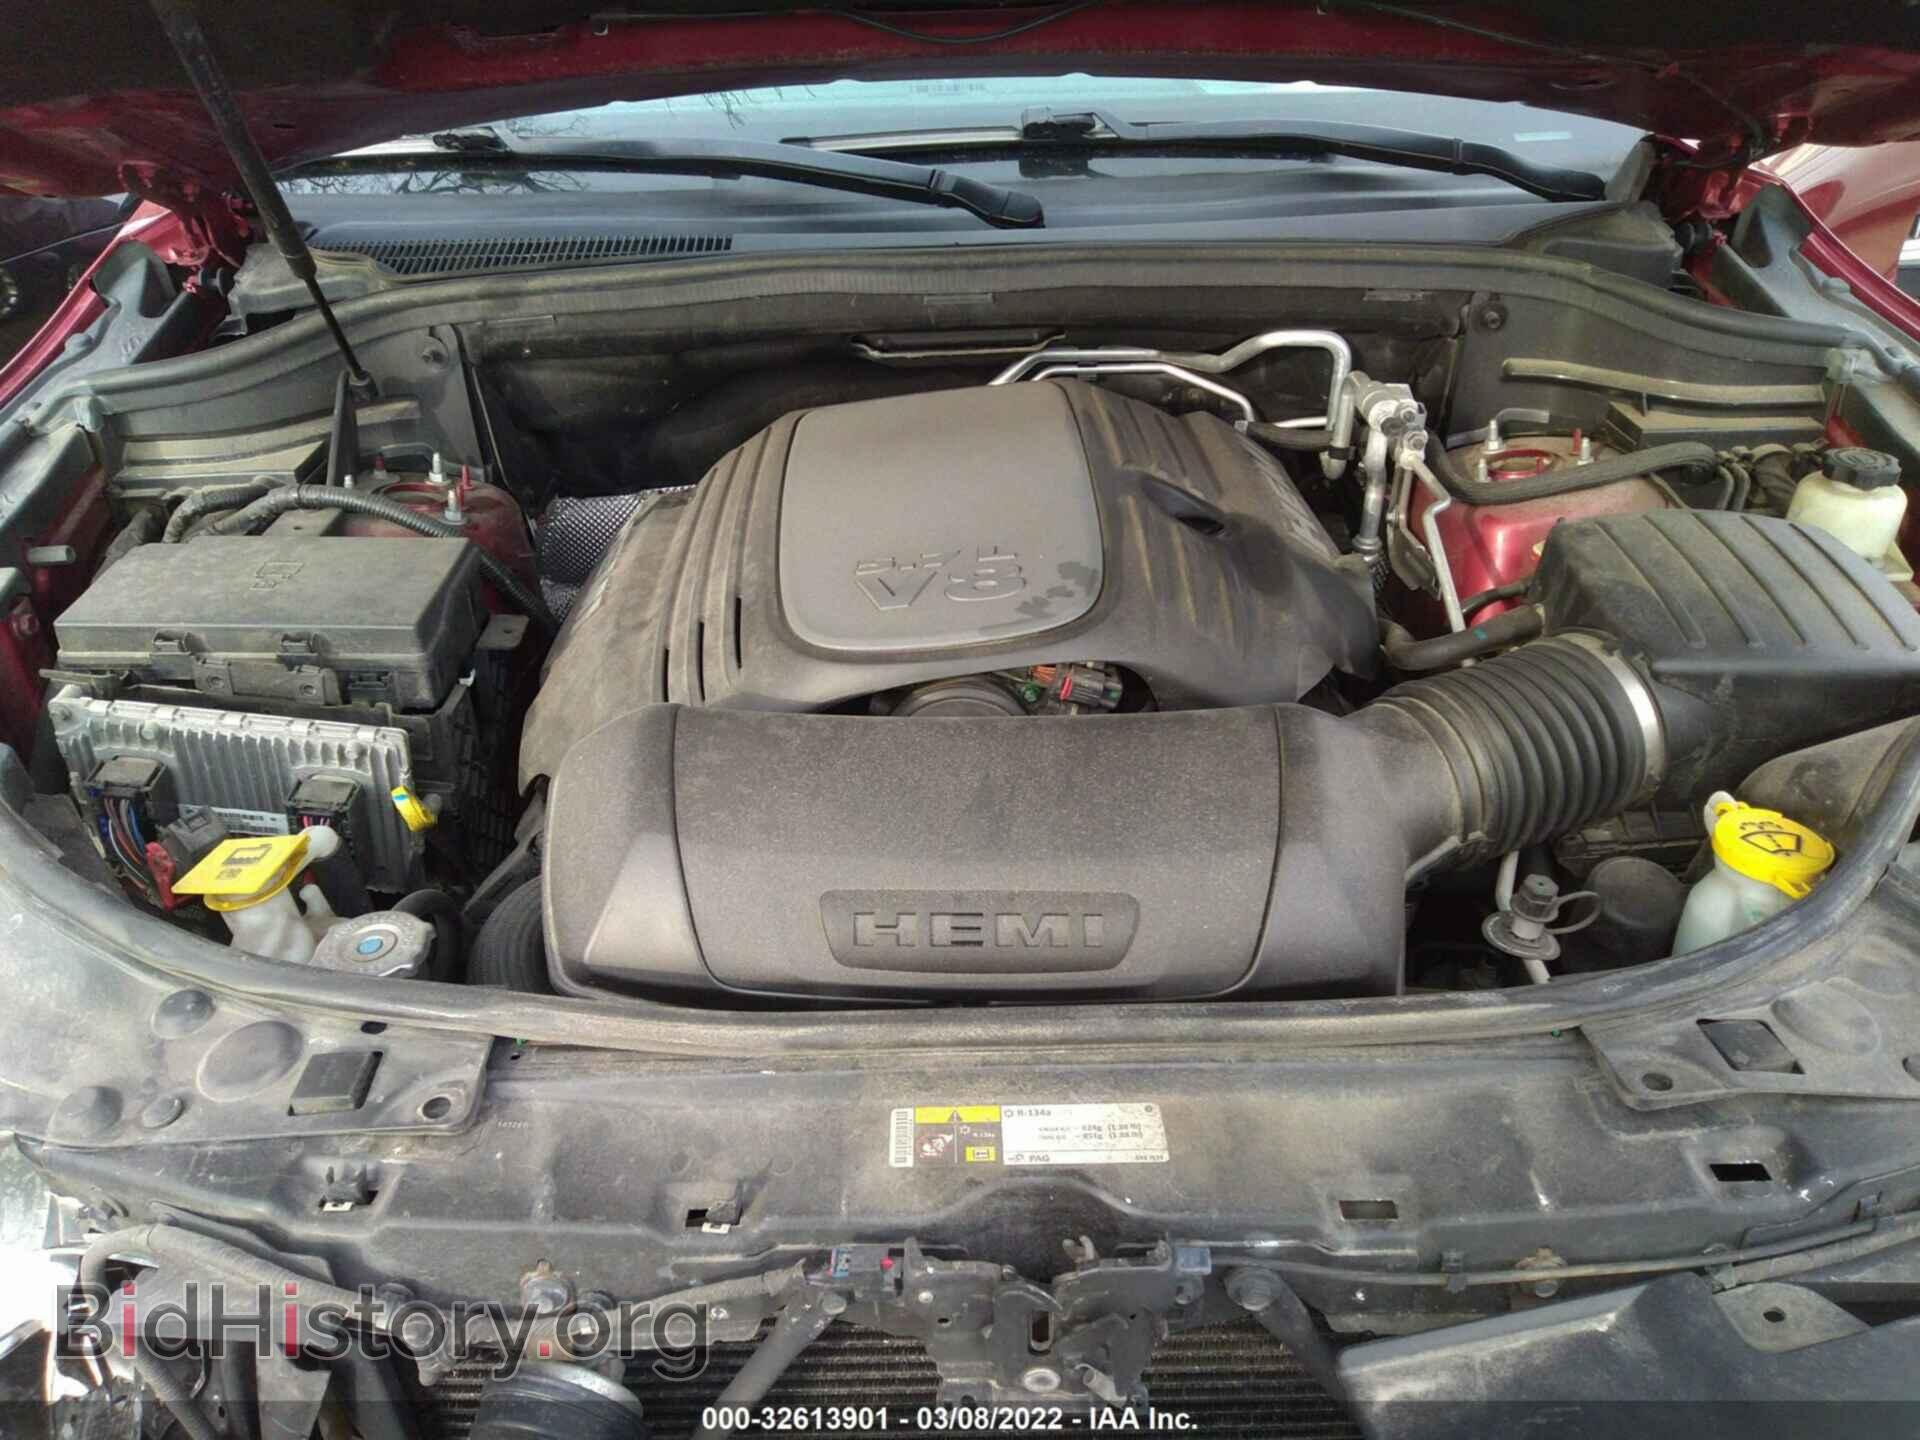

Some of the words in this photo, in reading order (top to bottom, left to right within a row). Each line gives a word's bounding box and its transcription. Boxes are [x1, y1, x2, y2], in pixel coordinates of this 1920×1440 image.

[855, 563, 1027, 610] V8
[852, 911, 1104, 947] HEMI
[1028, 1154, 1051, 1163] PAG
